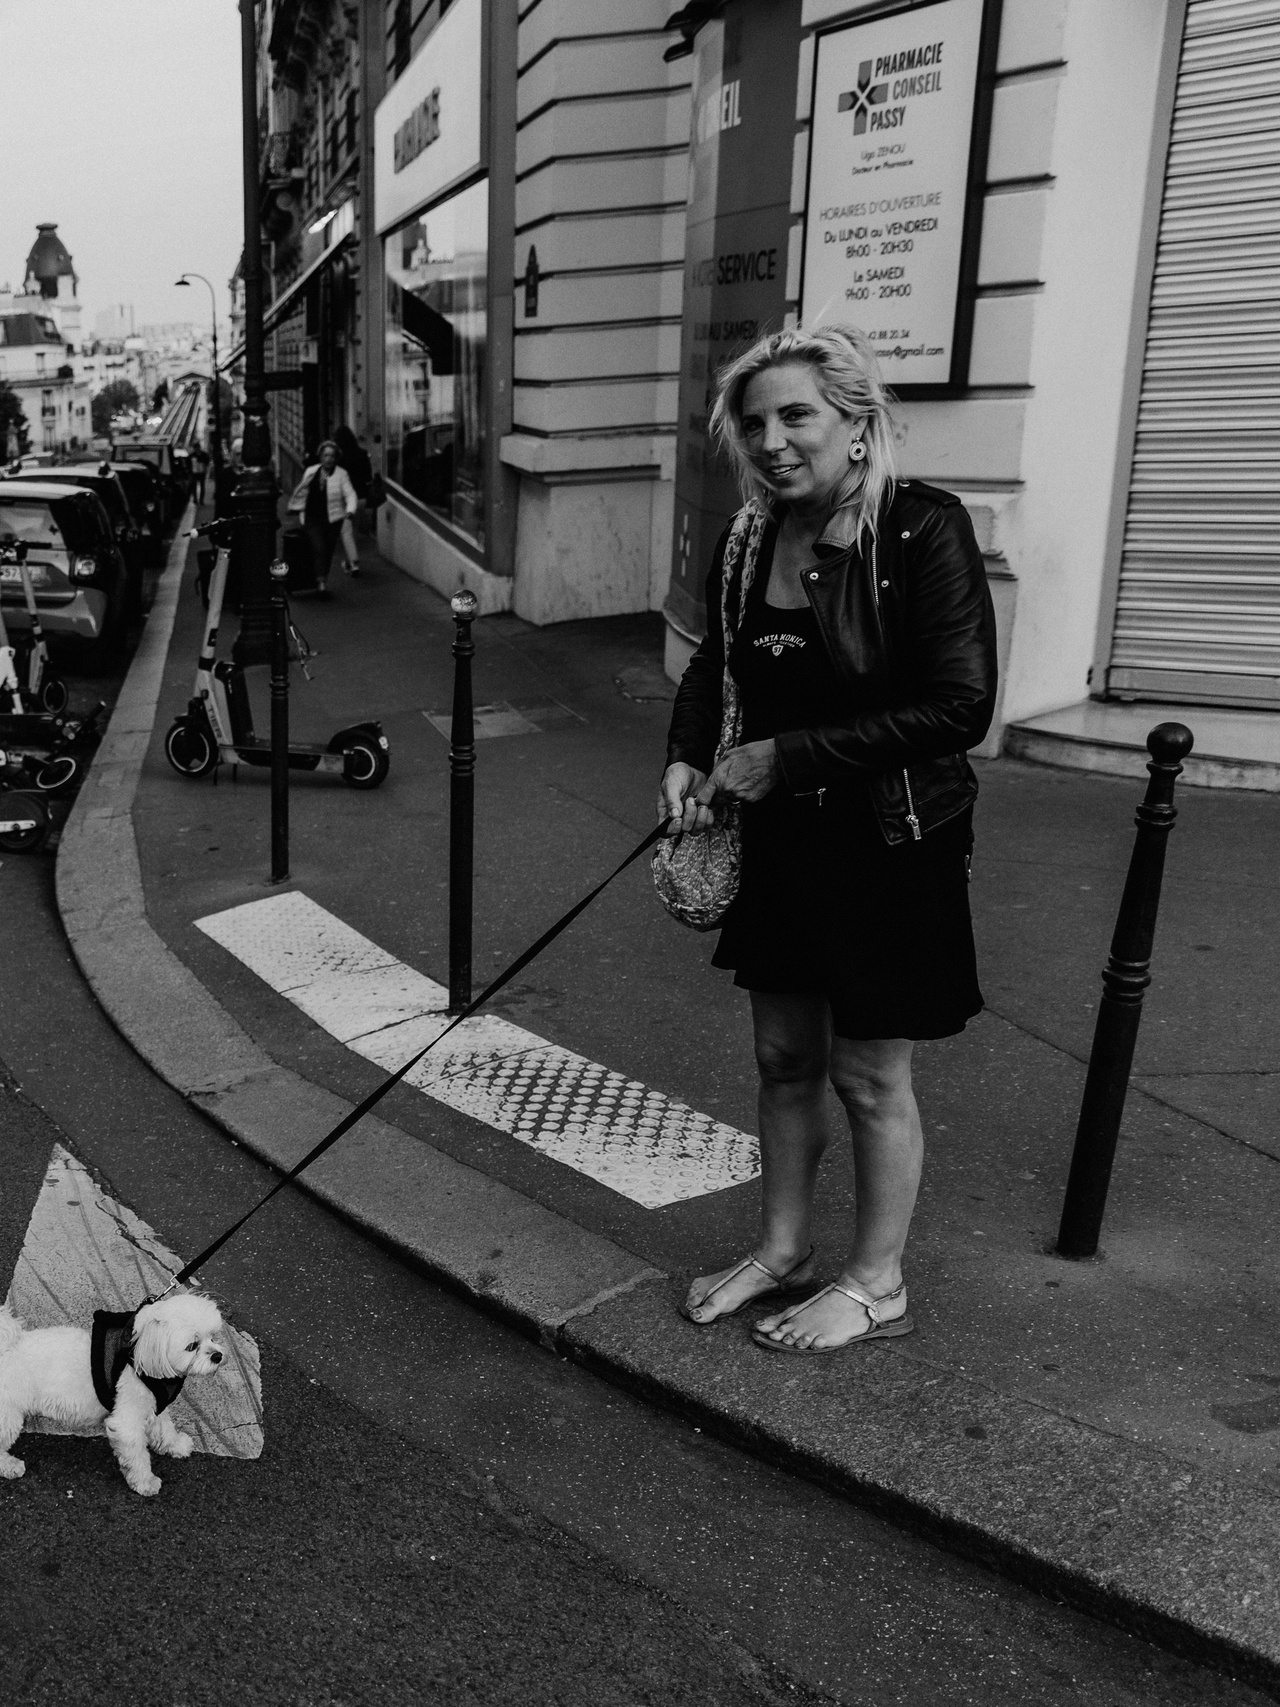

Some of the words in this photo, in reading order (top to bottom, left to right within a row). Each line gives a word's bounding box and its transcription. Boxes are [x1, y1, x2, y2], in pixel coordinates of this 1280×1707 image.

[875, 42, 943, 78] PHARMACIE
[893, 71, 942, 100] CONSEIL
[870, 106, 906, 132] PASSY
[820, 202, 867, 220] HORAIRES
[824, 231, 837, 243] Du
[839, 227, 868, 242] LUNDI
[871, 229, 883, 238] au
[886, 218, 938, 235] VENDREDI
[880, 239, 914, 255] 20H30
[717, 248, 777, 285] SERVICE
[854, 271, 863, 283] Le
[866, 266, 905, 282] SAMEDI
[879, 283, 912, 299] 20H00
[753, 634, 778, 647] SANTA
[780, 633, 807, 648] MONICA
